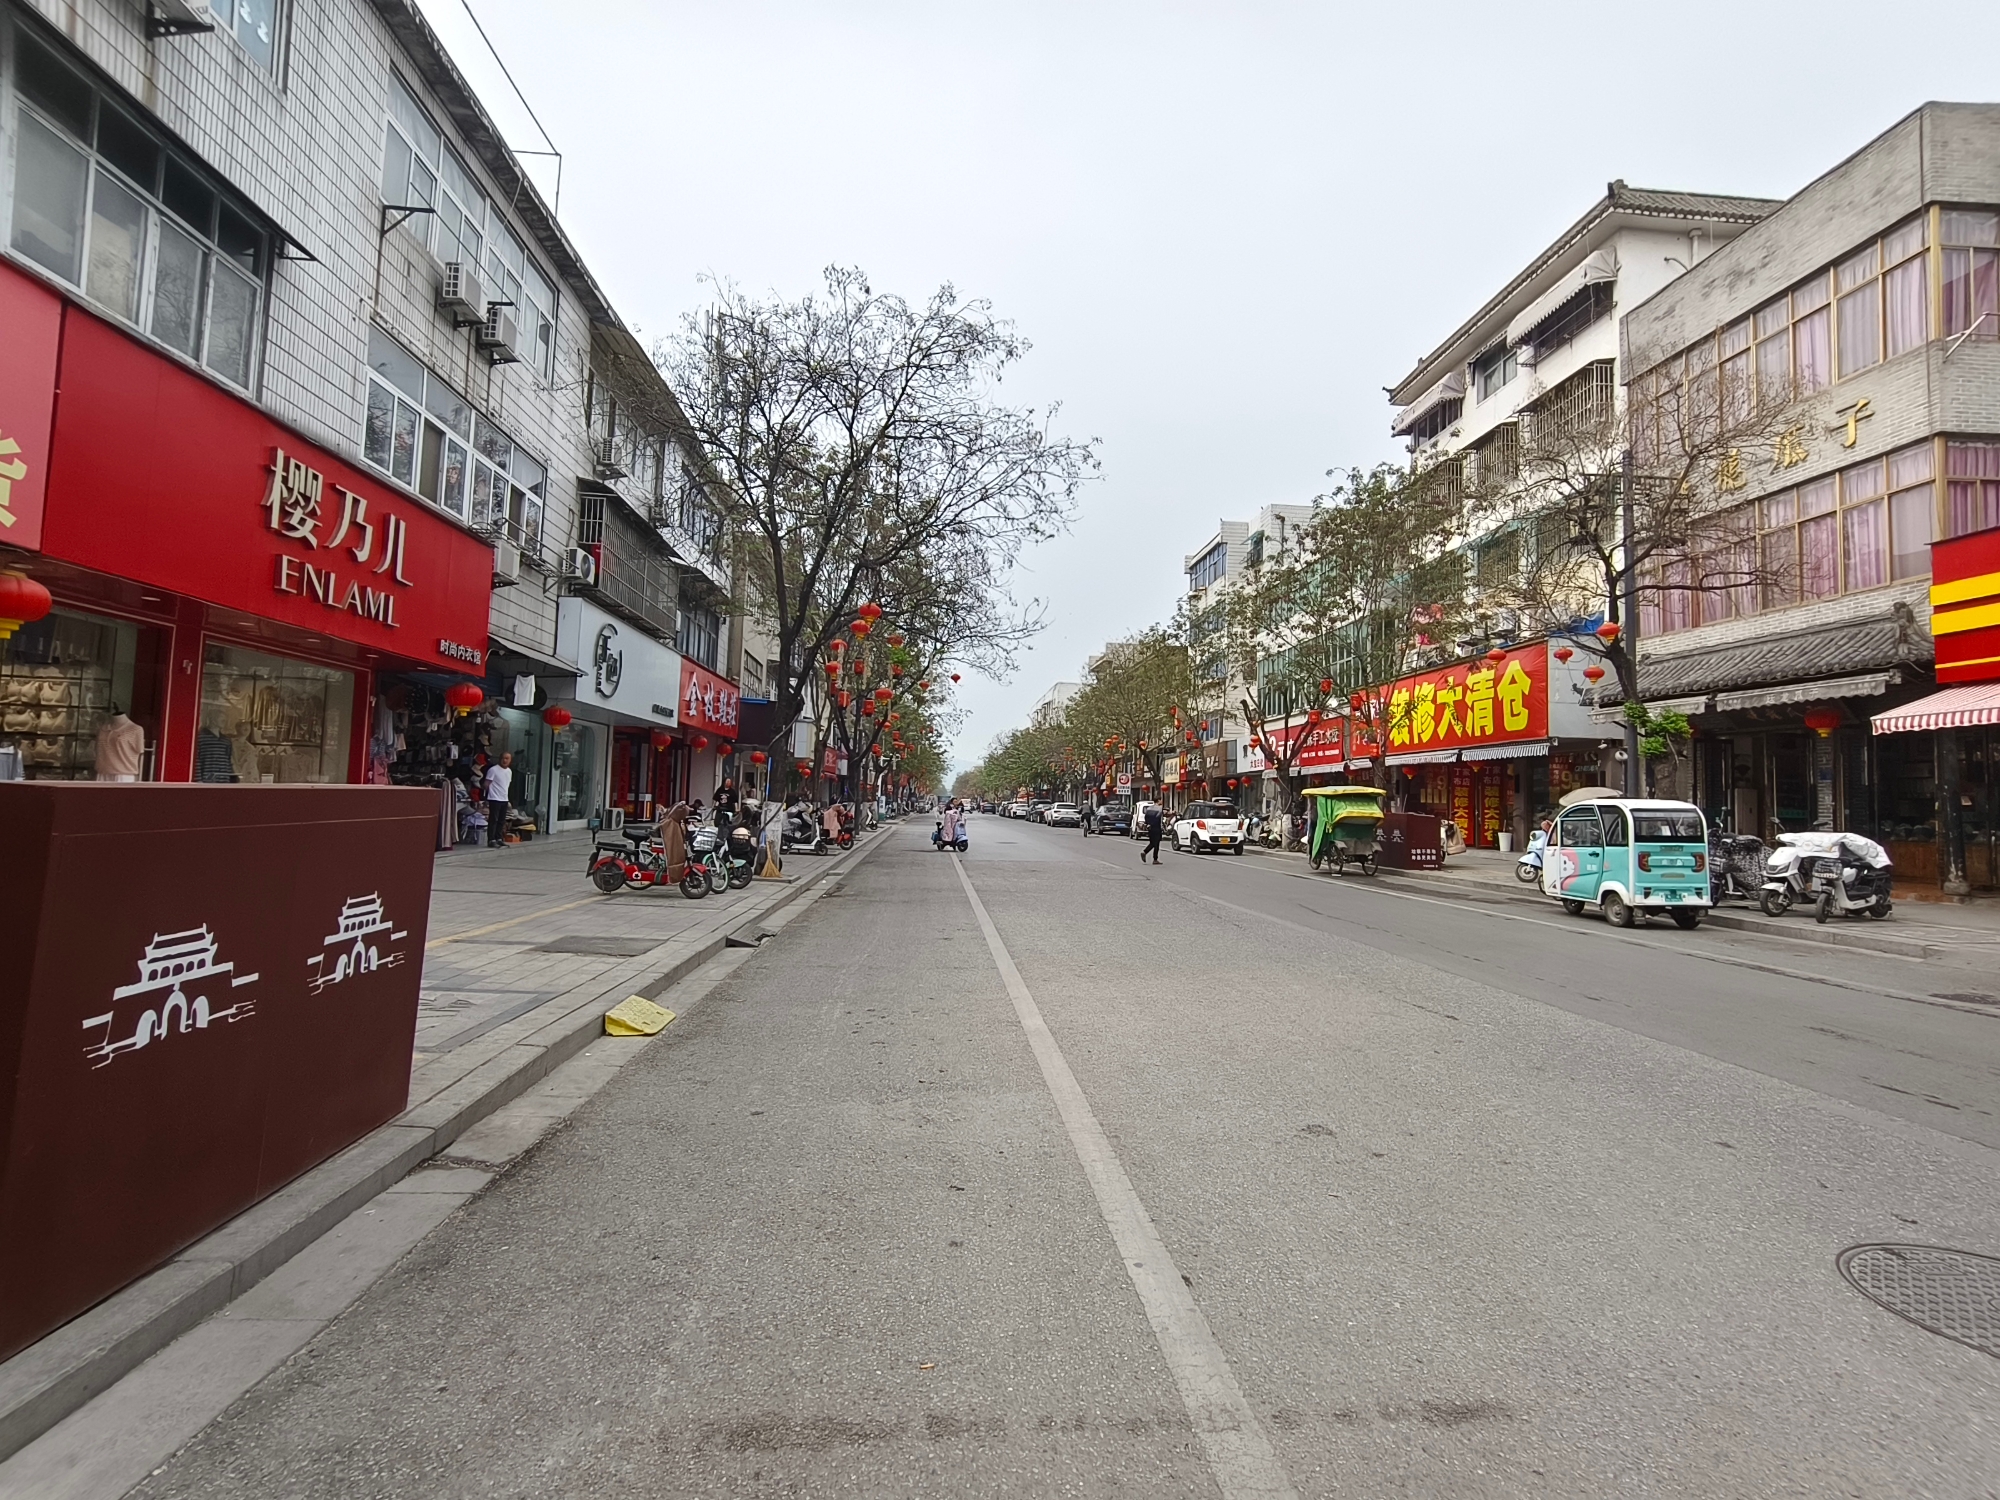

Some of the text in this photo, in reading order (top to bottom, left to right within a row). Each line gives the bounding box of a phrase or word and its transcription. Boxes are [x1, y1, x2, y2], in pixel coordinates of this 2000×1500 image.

[264, 446, 414, 587] 樱乃儿
[440, 638, 482, 665] 时尚内衣馆
[1389, 659, 1532, 747] 装修大清仓
